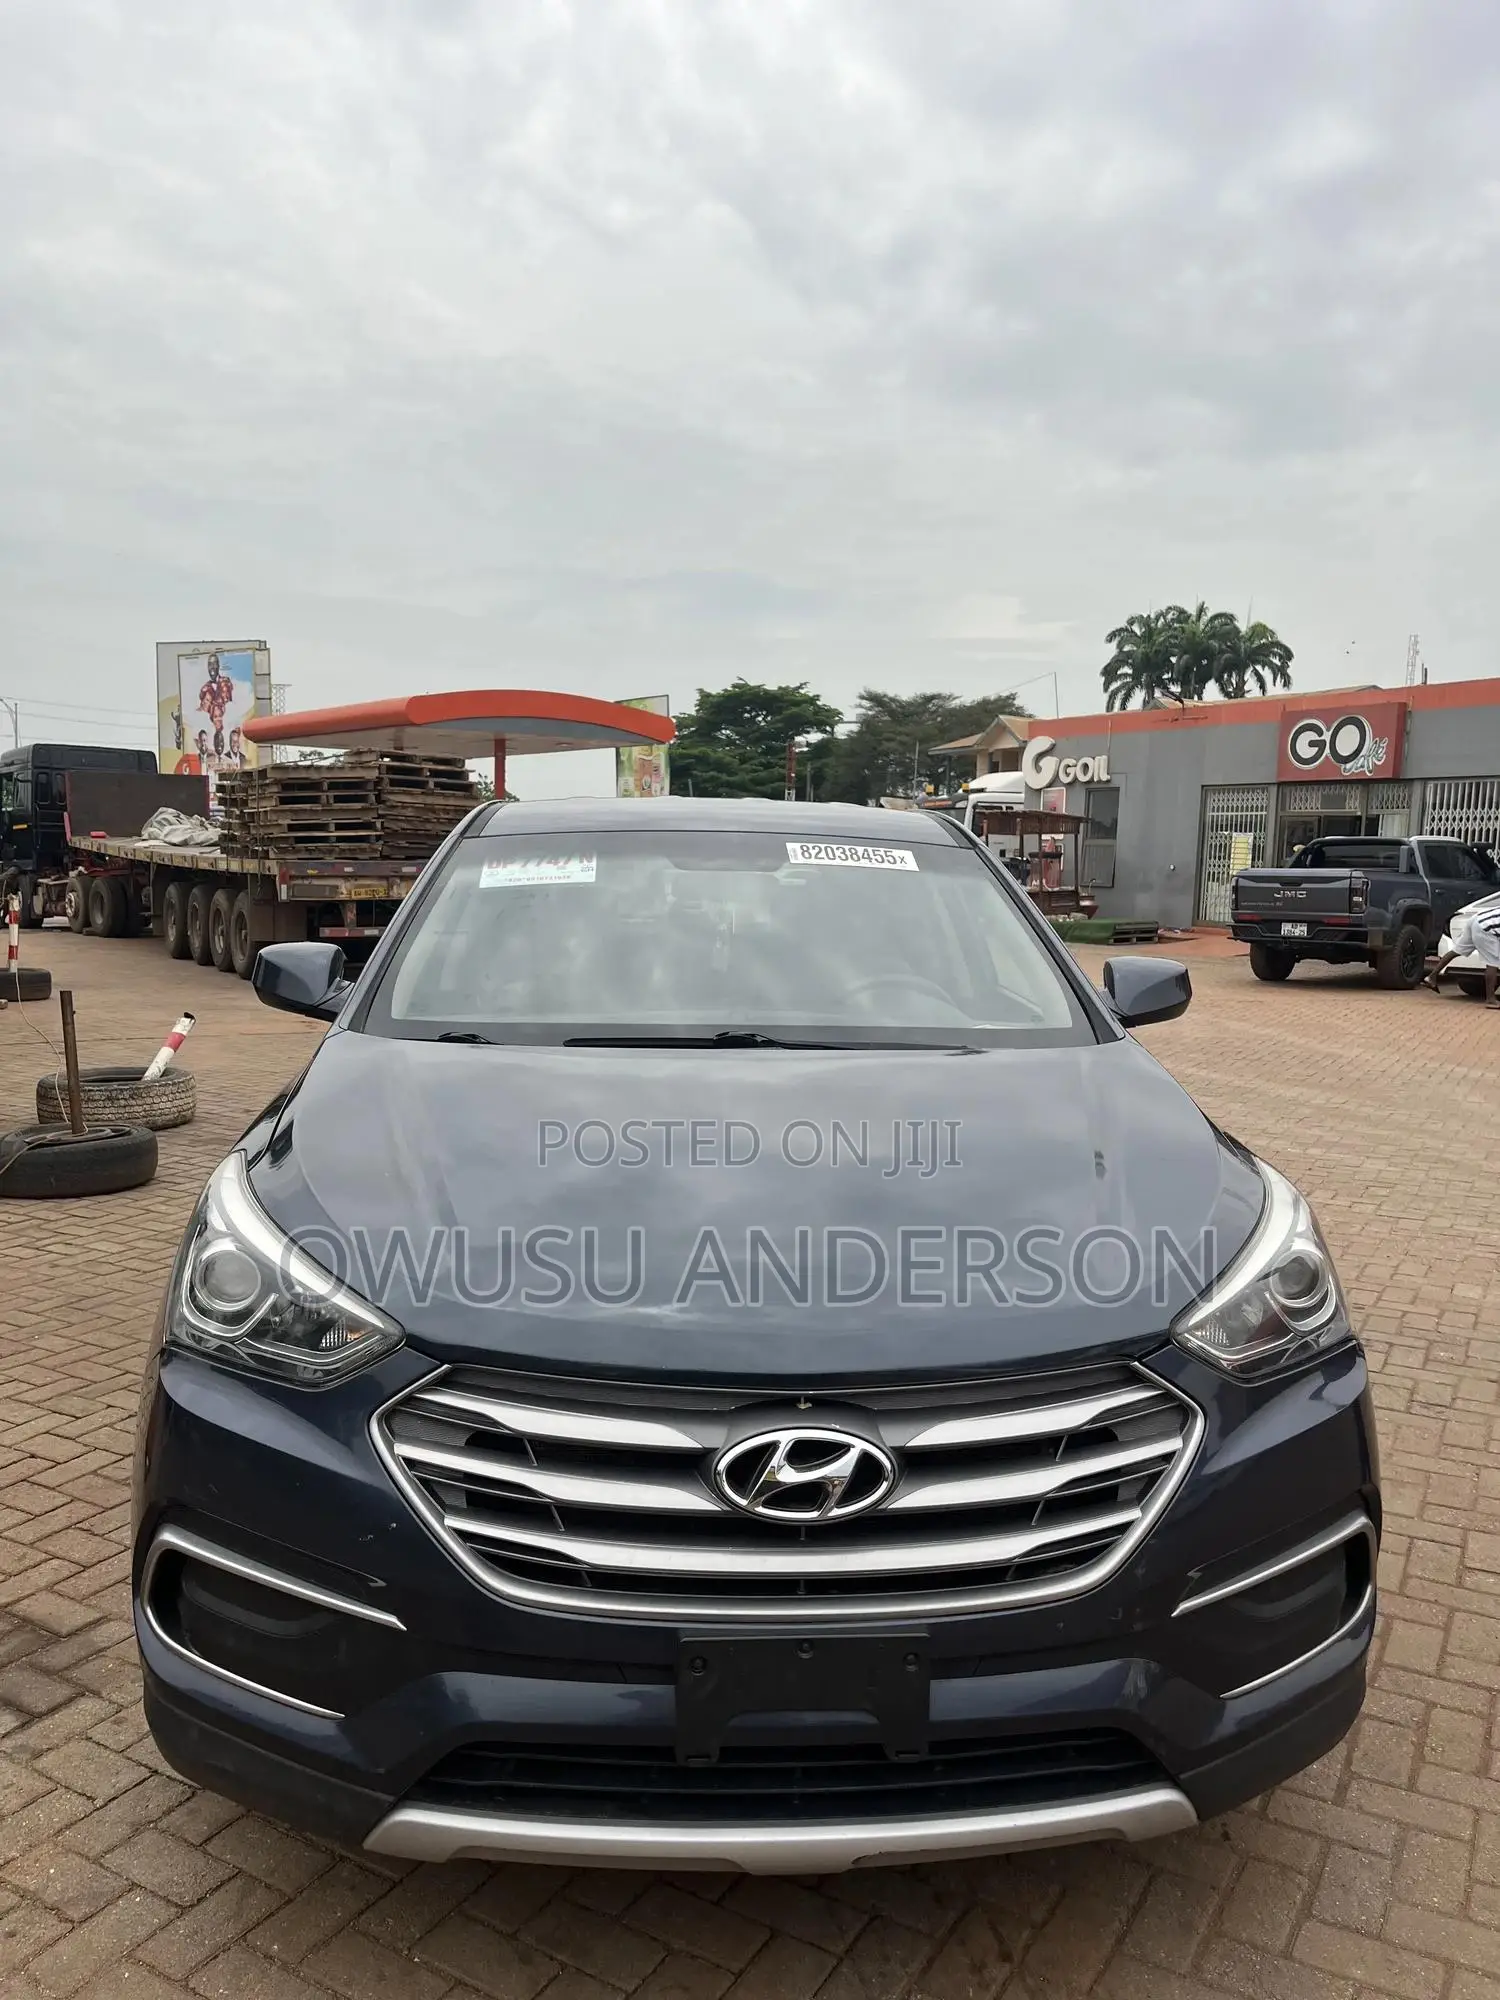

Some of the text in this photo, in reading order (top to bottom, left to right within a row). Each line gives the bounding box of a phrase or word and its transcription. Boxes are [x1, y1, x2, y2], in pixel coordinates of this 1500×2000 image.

[1288, 715, 1373, 769] GO
[1059, 755, 1111, 784] GOIL
[1273, 890, 1307, 898] JMC
